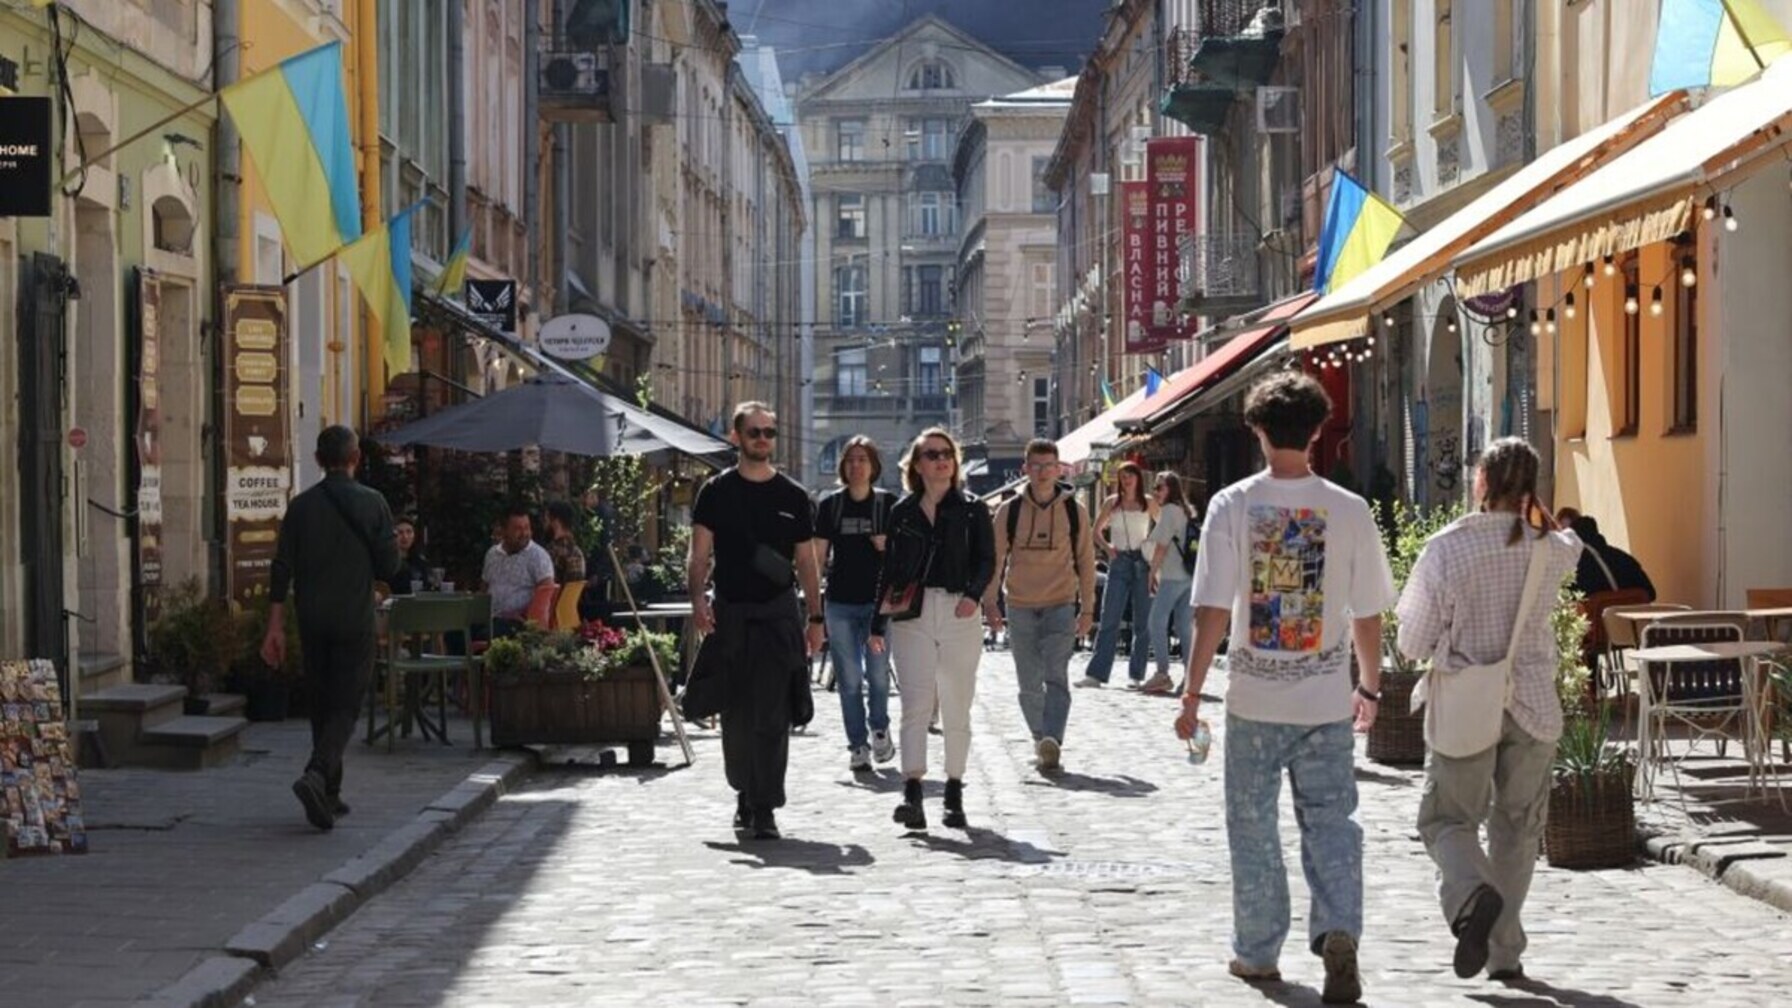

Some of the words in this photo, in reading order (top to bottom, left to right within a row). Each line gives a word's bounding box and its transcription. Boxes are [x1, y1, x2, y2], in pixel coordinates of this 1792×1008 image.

[0, 144, 38, 155] HOME
[1156, 203, 1169, 297] ПИВНИЙ
[1129, 234, 1143, 317] ВЛАСНА
[238, 477, 279, 488] COFFEE
[232, 499, 249, 509] TEA
[250, 498, 281, 508] HOUSE
